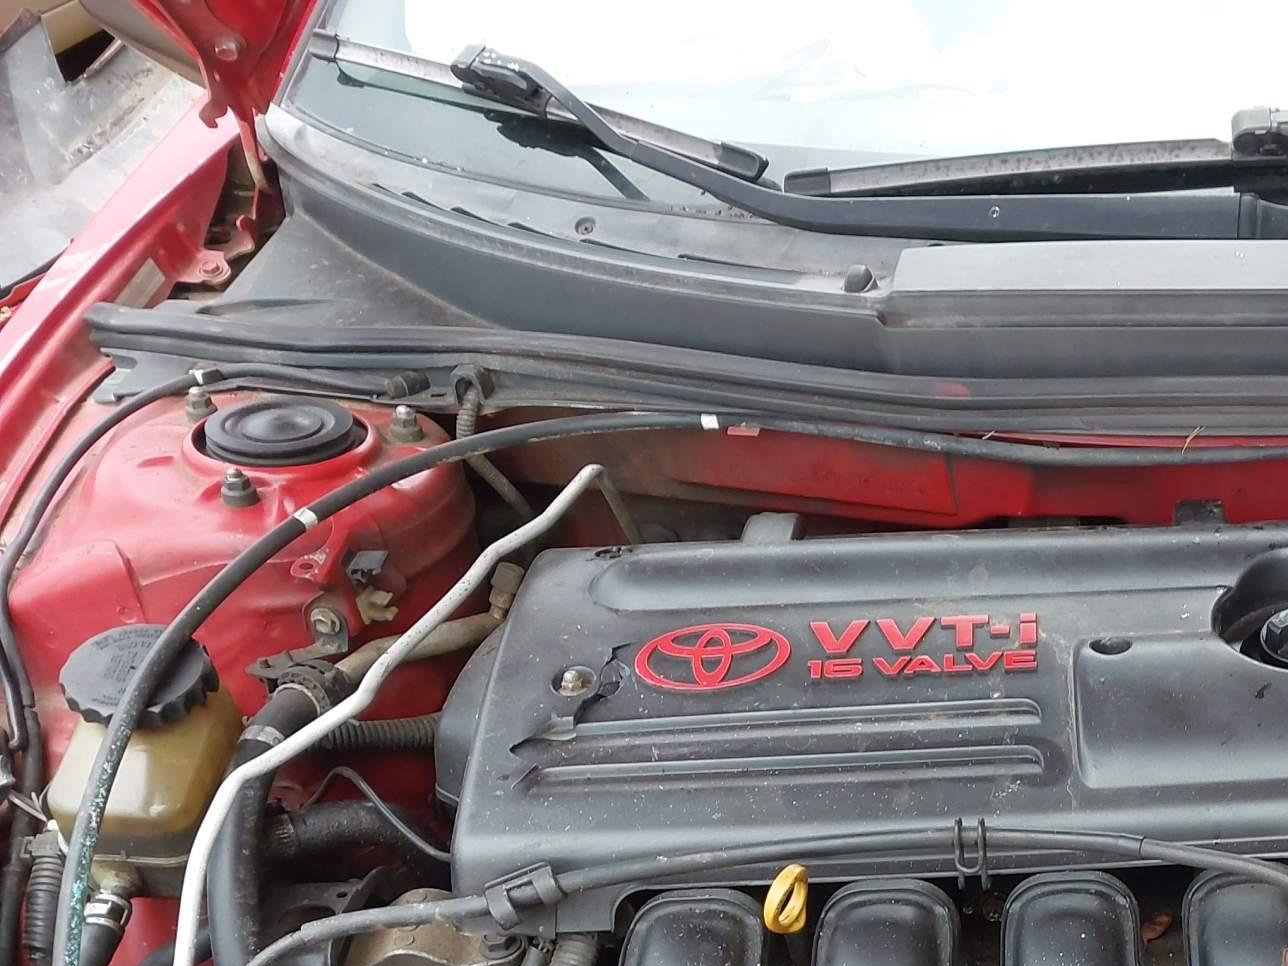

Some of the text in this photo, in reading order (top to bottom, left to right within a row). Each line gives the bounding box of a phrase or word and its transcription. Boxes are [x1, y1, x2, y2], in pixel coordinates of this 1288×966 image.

[810, 611, 1038, 654] VVT-i
[807, 650, 1038, 679] 16 VALVE
